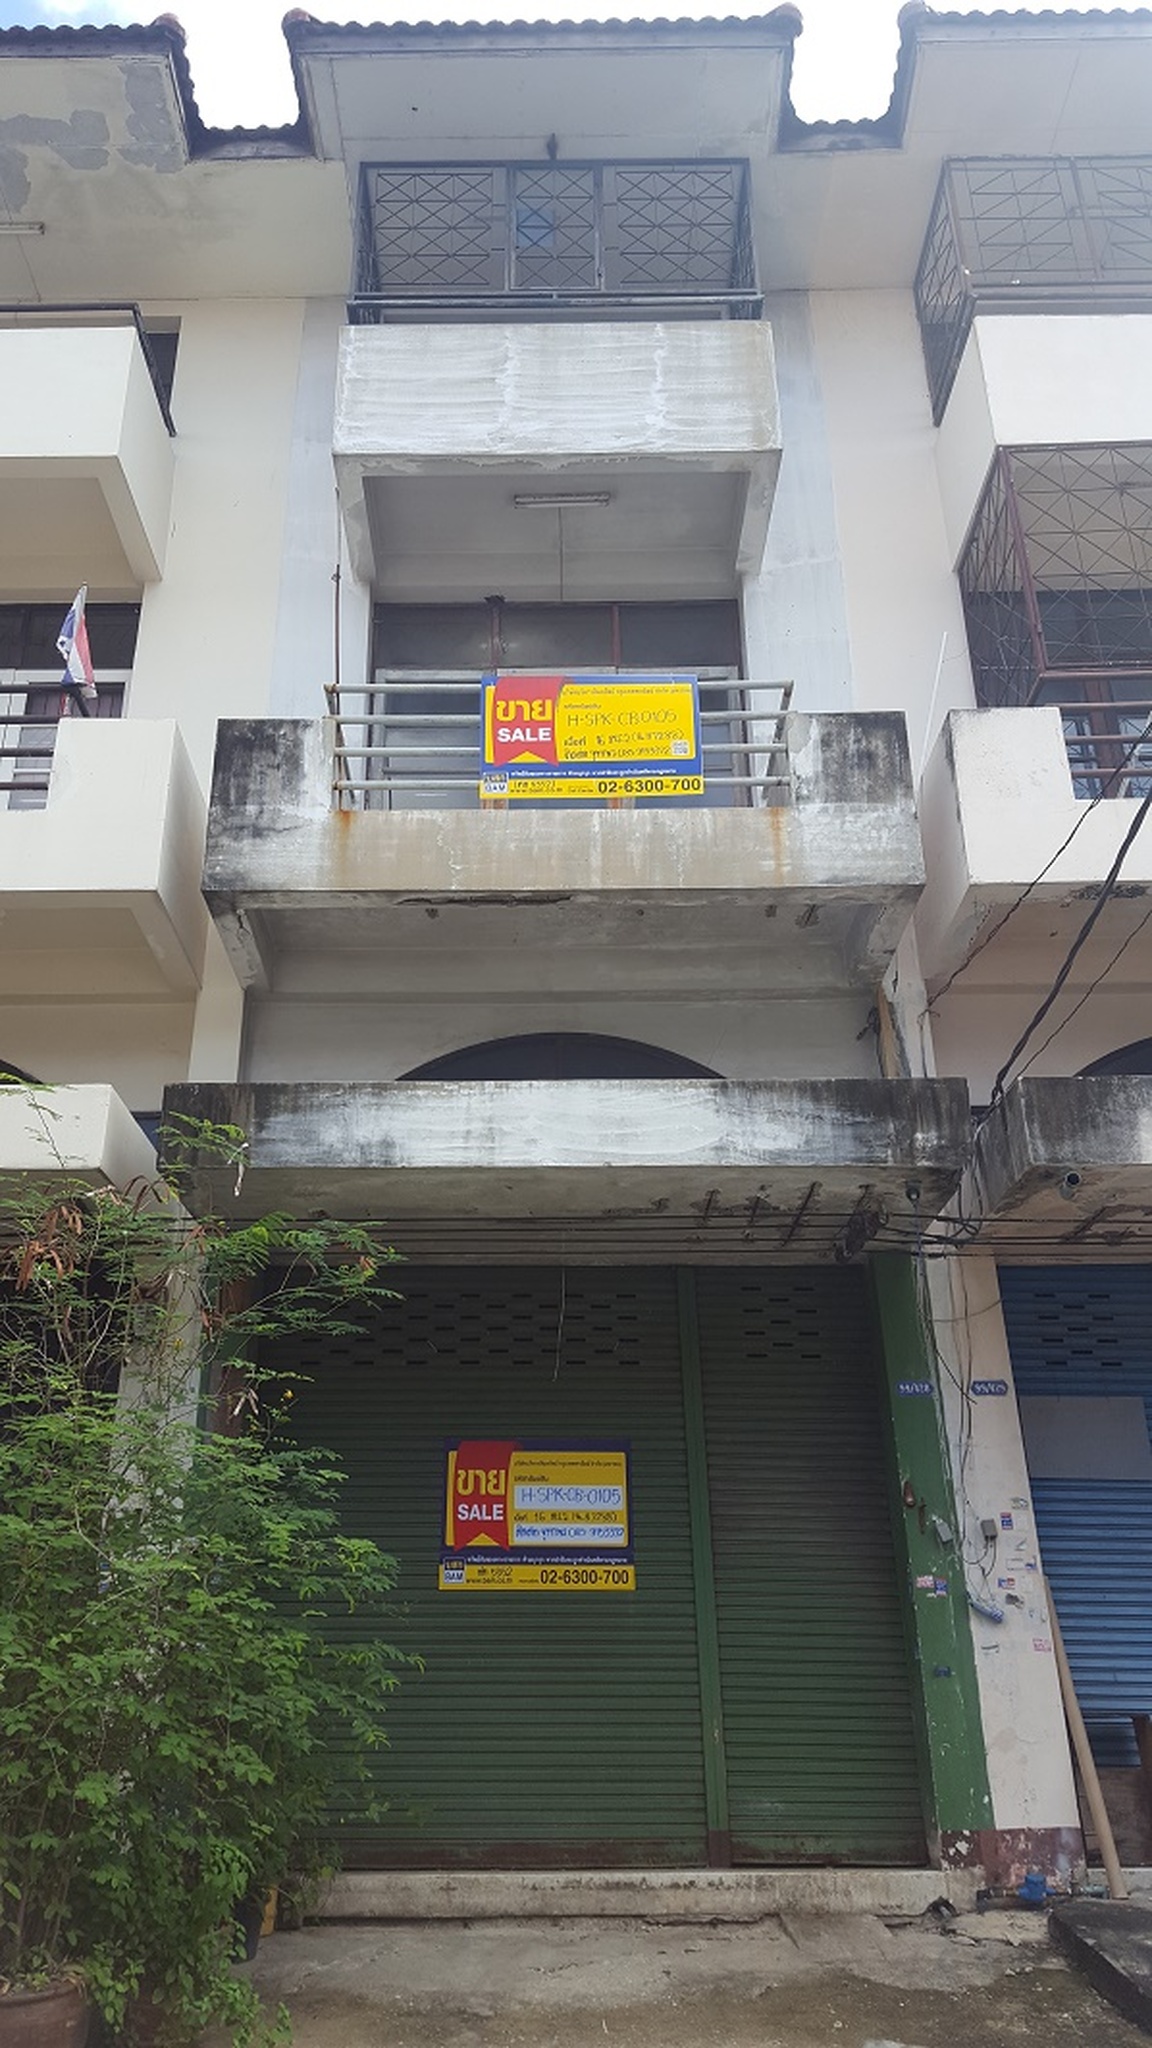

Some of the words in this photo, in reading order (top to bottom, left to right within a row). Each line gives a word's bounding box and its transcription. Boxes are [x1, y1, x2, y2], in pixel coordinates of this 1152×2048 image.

[496, 699, 552, 722] ขาย
[497, 727, 552, 742] SALE
[597, 777, 701, 794] 02-6300-700
[457, 1469, 506, 1496] ขาย
[457, 1504, 504, 1521] SALE
[540, 1569, 629, 1585] 02-6300-700
